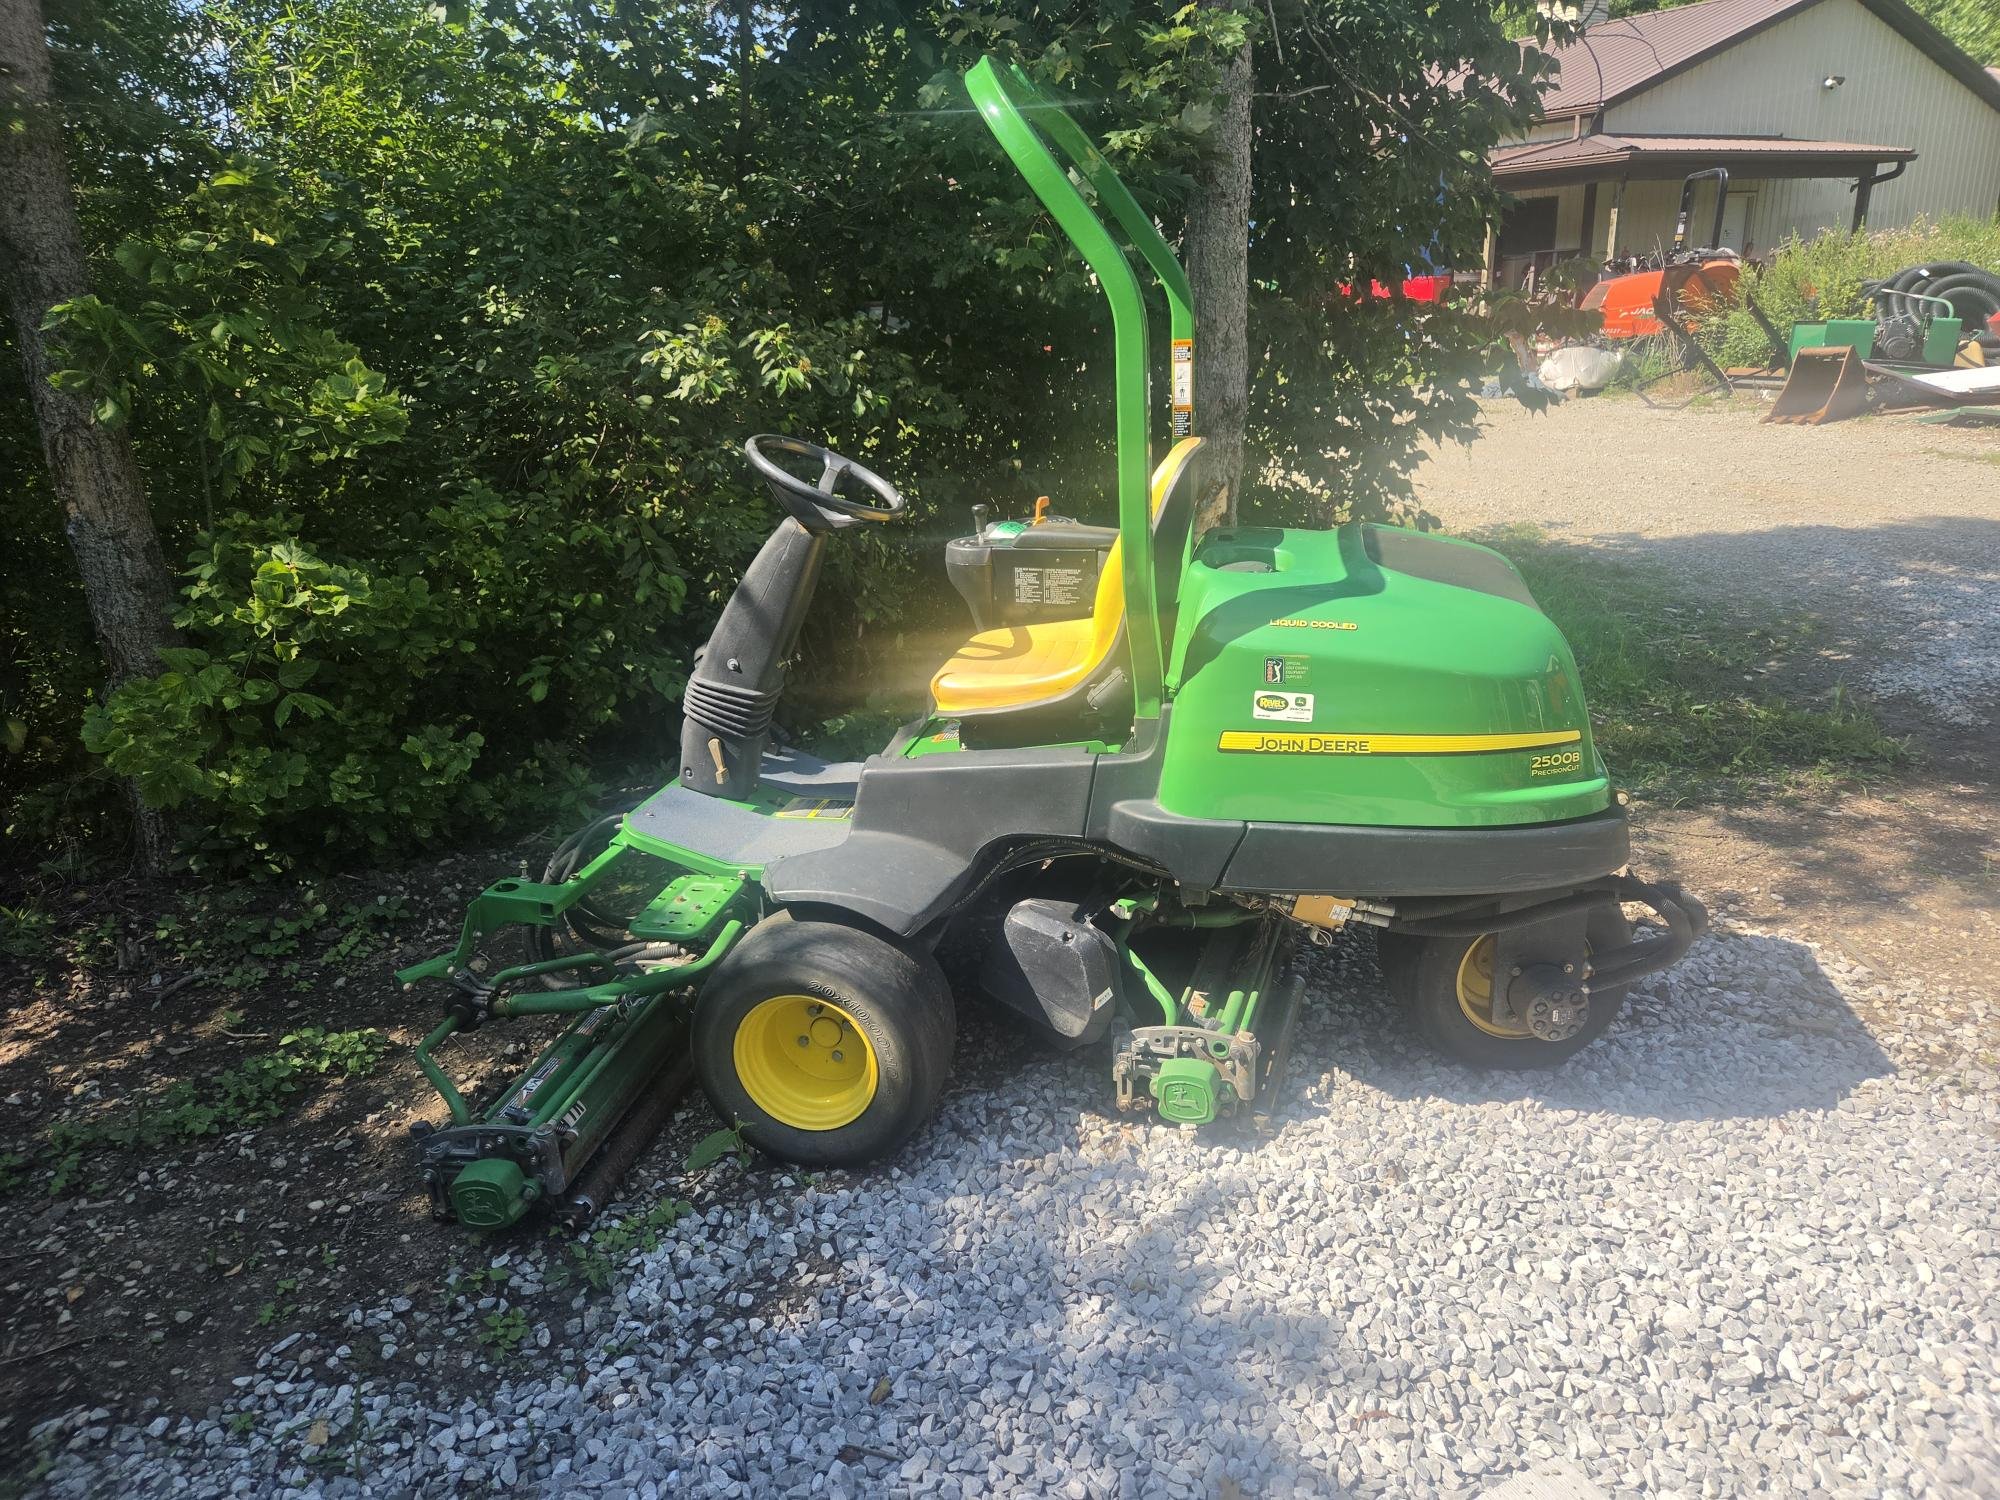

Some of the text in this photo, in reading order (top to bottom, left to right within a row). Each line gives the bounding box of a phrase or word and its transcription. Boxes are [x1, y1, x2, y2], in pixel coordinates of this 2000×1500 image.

[1269, 618, 1358, 631] LIQUID COOLED
[1254, 736, 1370, 752] JOHN DEERE
[1531, 752, 1580, 769] 2500B
